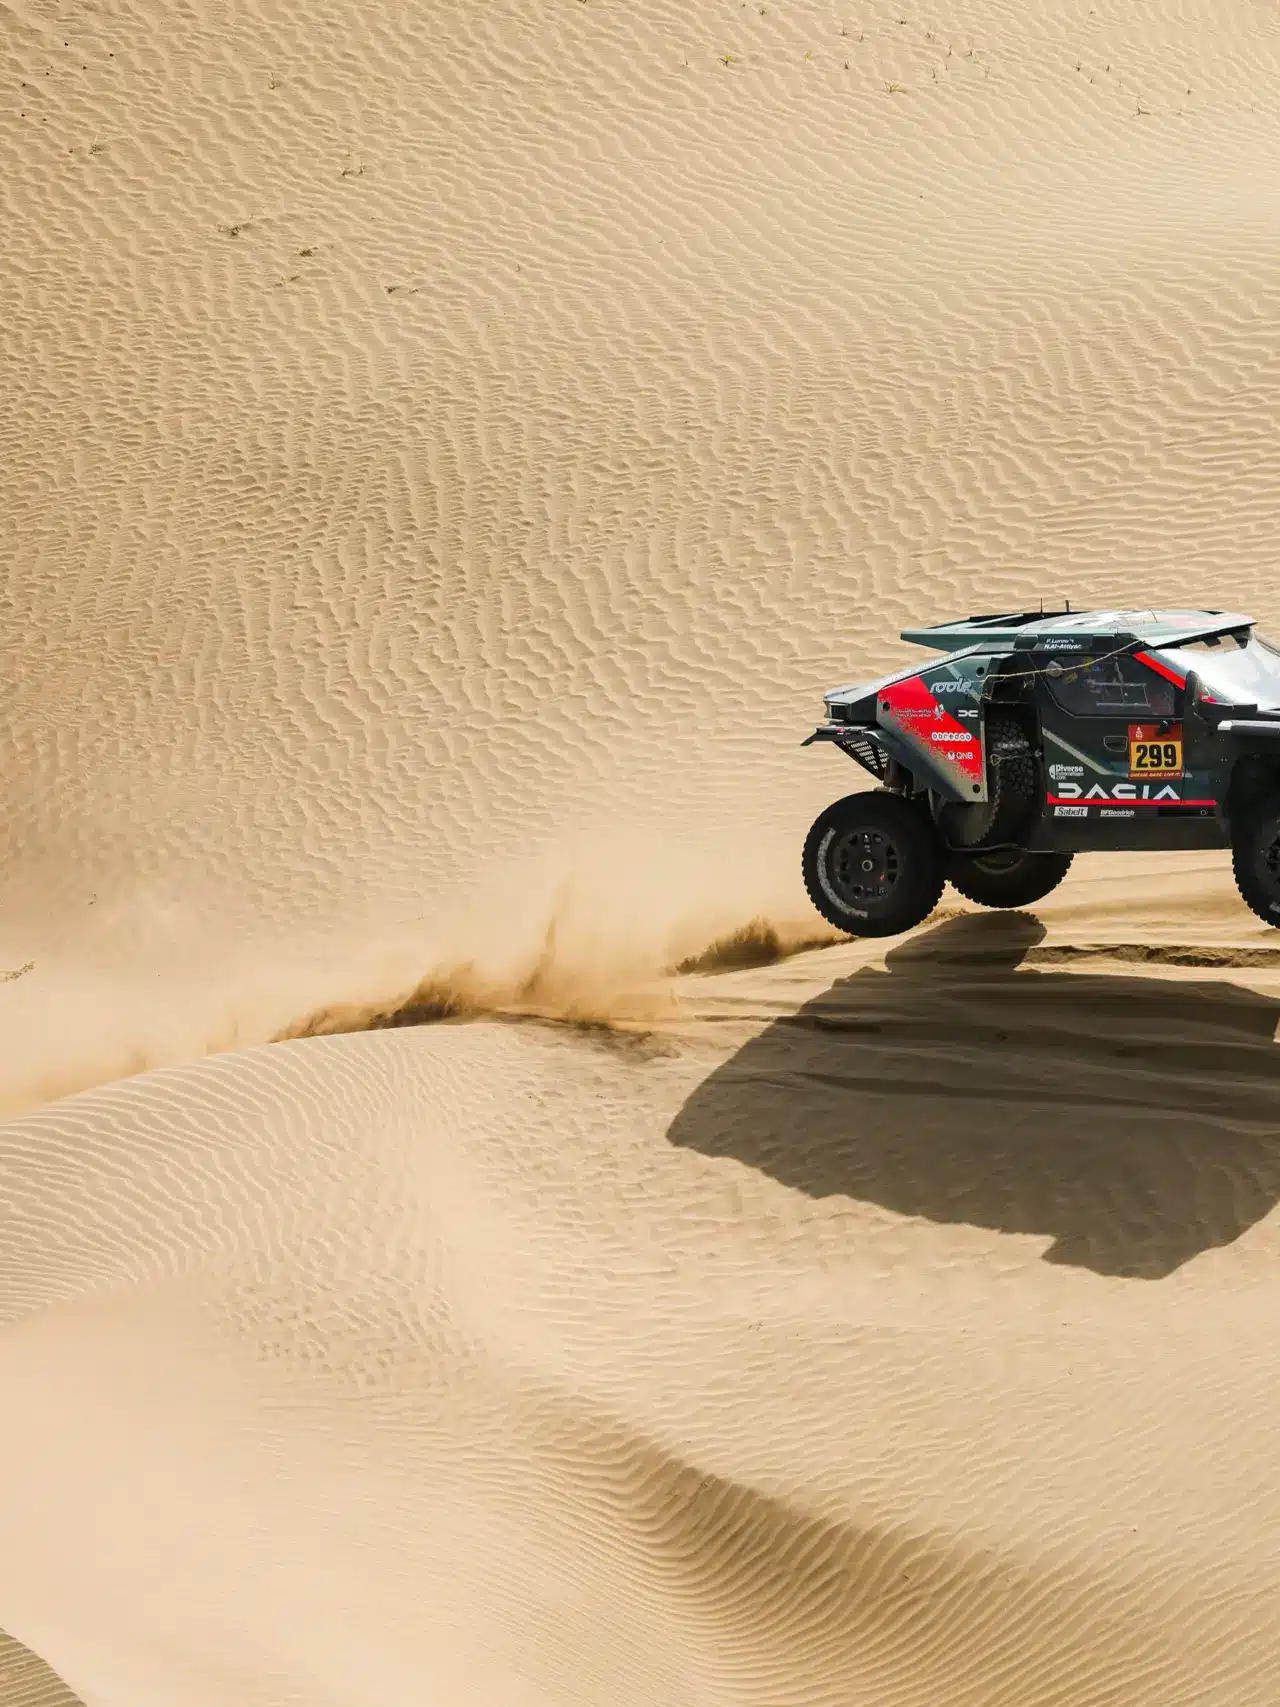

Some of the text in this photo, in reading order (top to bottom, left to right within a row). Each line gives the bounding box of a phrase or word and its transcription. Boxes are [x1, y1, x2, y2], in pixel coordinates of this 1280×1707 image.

[930, 677, 972, 693] roole
[932, 732, 972, 741] ooredoo
[956, 752, 974, 760] QNB
[1136, 744, 1176, 768] 299
[1056, 764, 1084, 772] Diverse
[1058, 782, 1180, 800] DACIA
[1058, 806, 1085, 816] Sabelt
